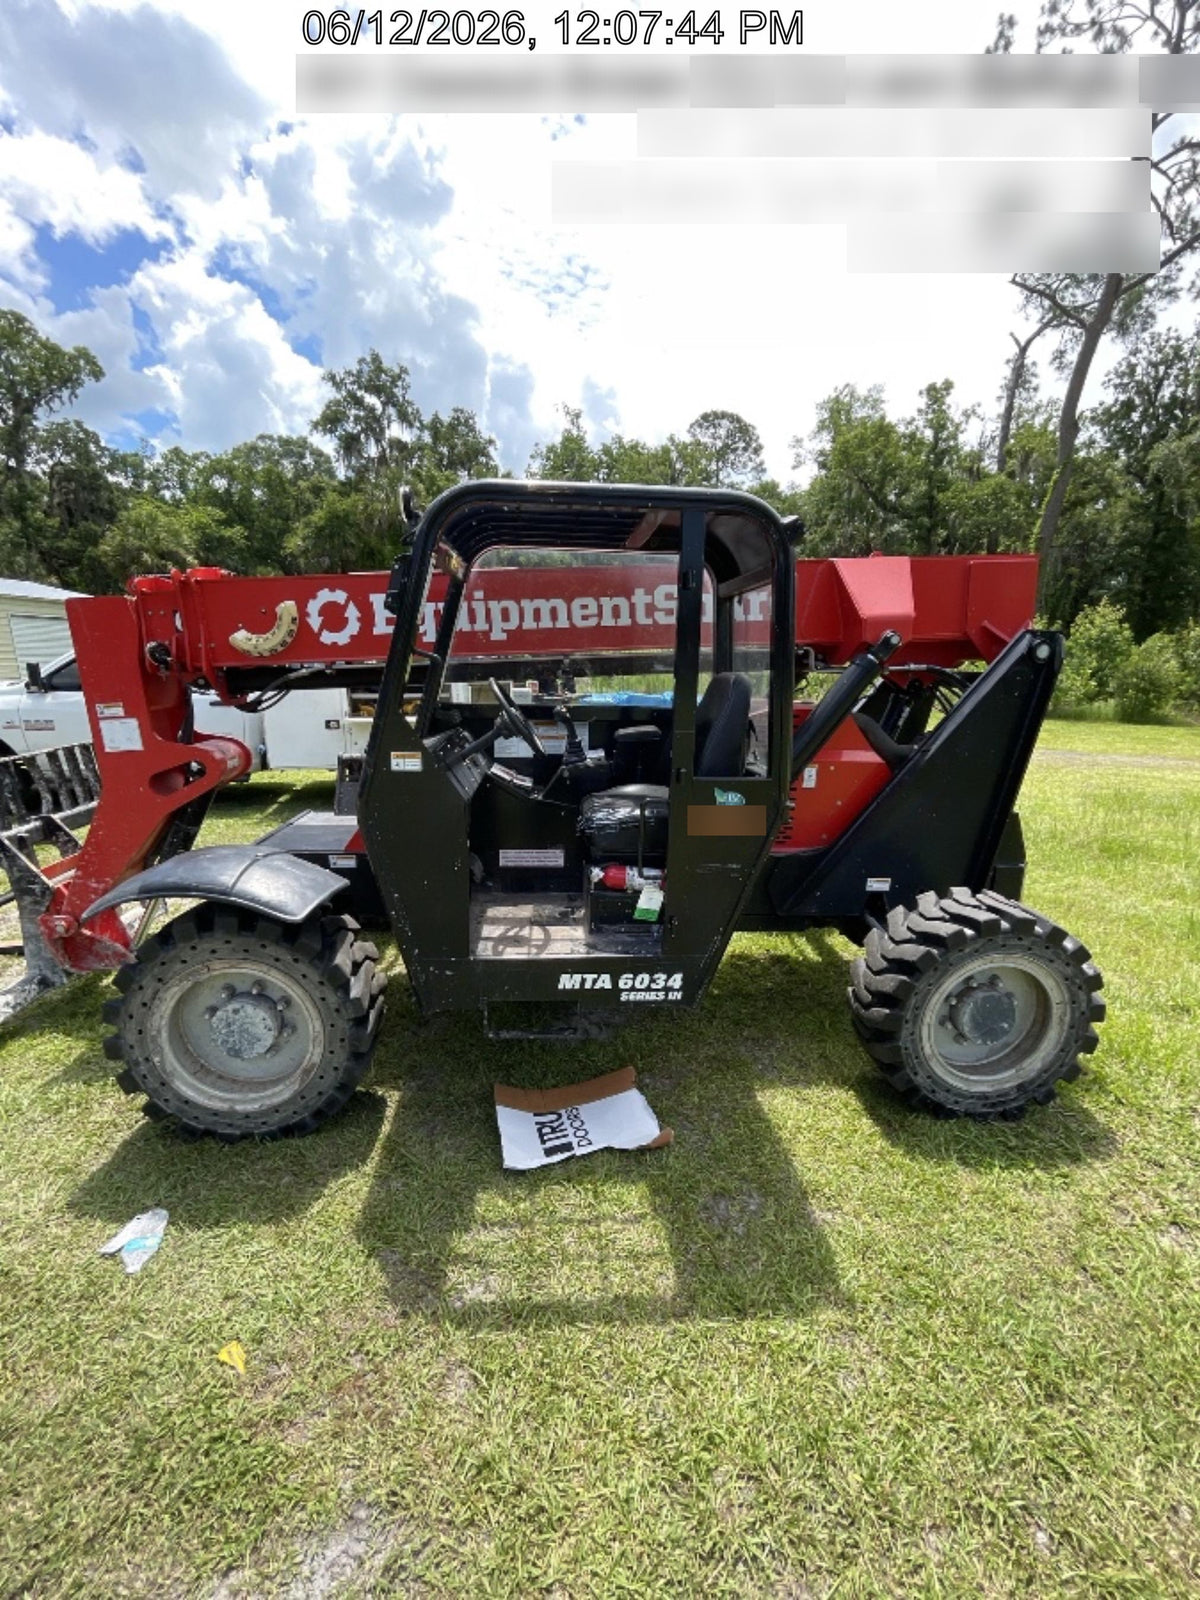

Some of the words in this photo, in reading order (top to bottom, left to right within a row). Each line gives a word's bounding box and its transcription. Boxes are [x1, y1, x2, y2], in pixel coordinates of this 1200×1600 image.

[558, 973, 613, 990] MTA
[618, 972, 684, 990] 6034
[620, 991, 666, 1002] SERIES
